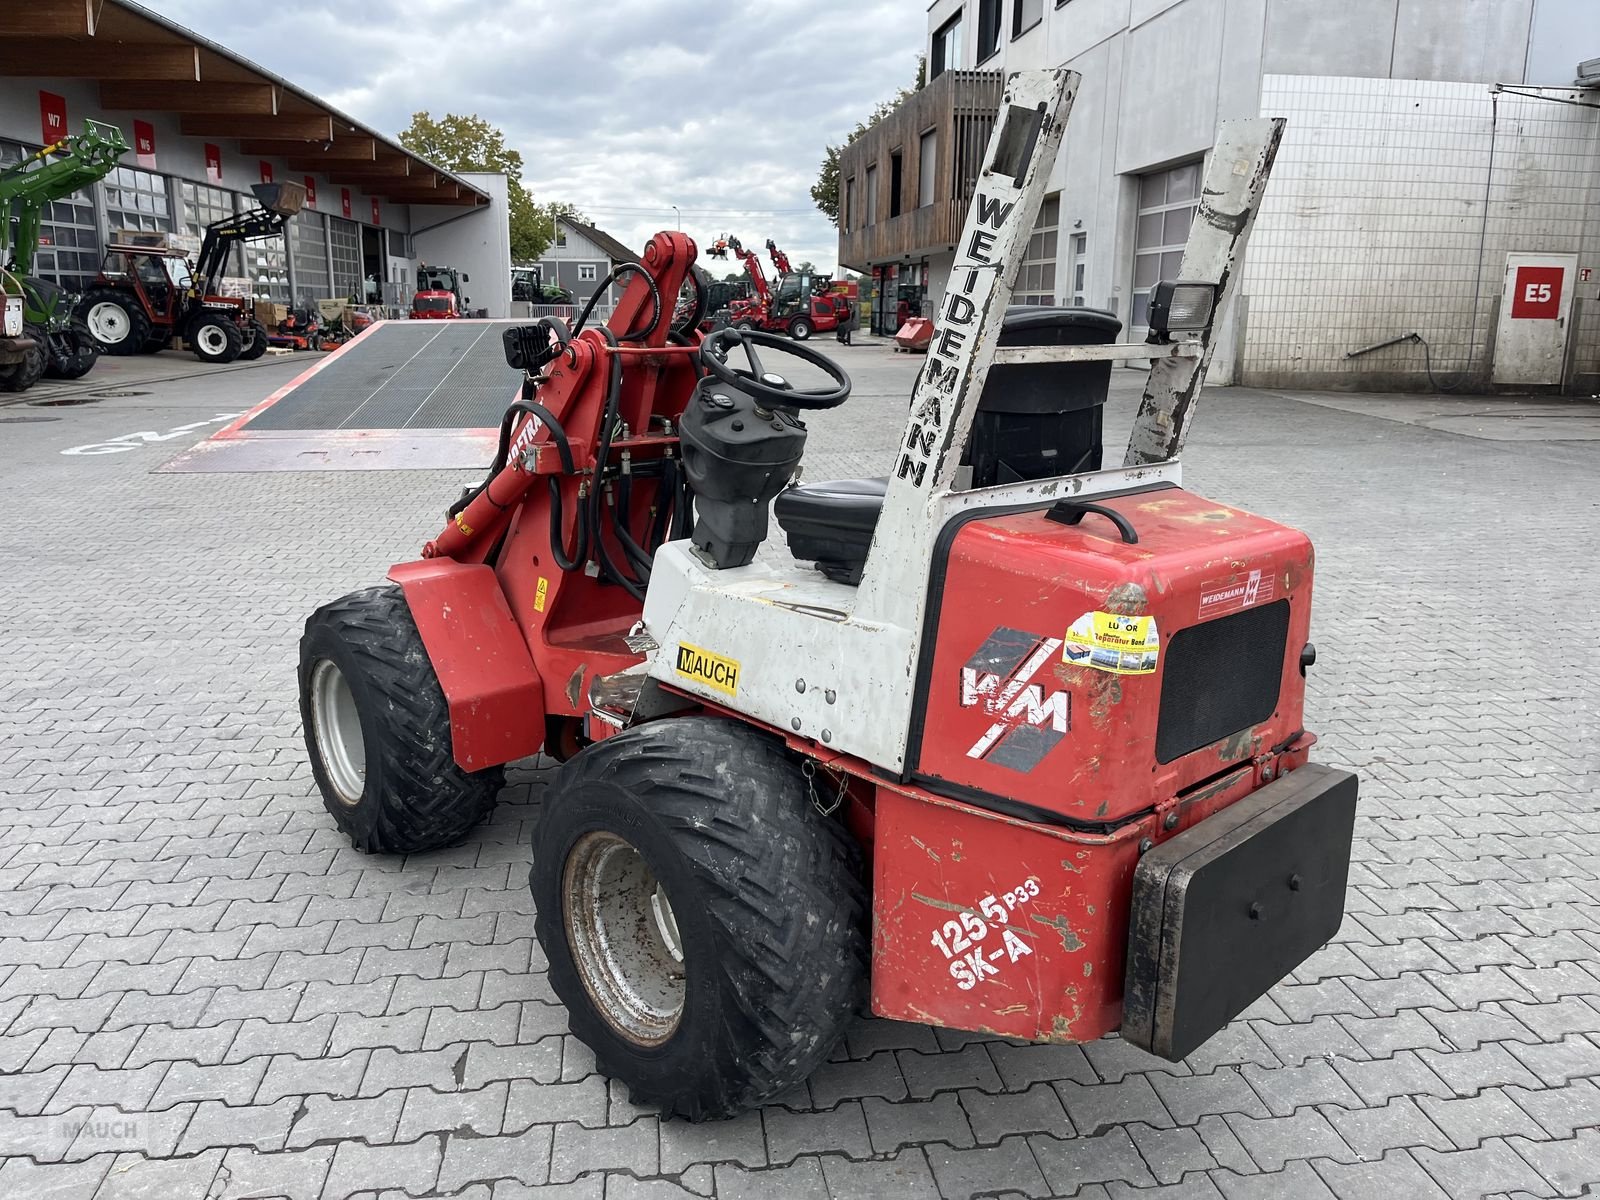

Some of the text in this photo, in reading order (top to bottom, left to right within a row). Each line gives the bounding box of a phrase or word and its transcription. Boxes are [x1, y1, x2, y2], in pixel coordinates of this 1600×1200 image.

[48, 112, 60, 128] W7
[1524, 283, 1552, 303] E5
[897, 193, 1014, 488] WEIDEMANN
[1202, 586, 1245, 605] WEIDEMANN
[677, 646, 737, 689] MAUCH
[930, 879, 1040, 959] 1255 P33
[949, 929, 1034, 991] SK-A
